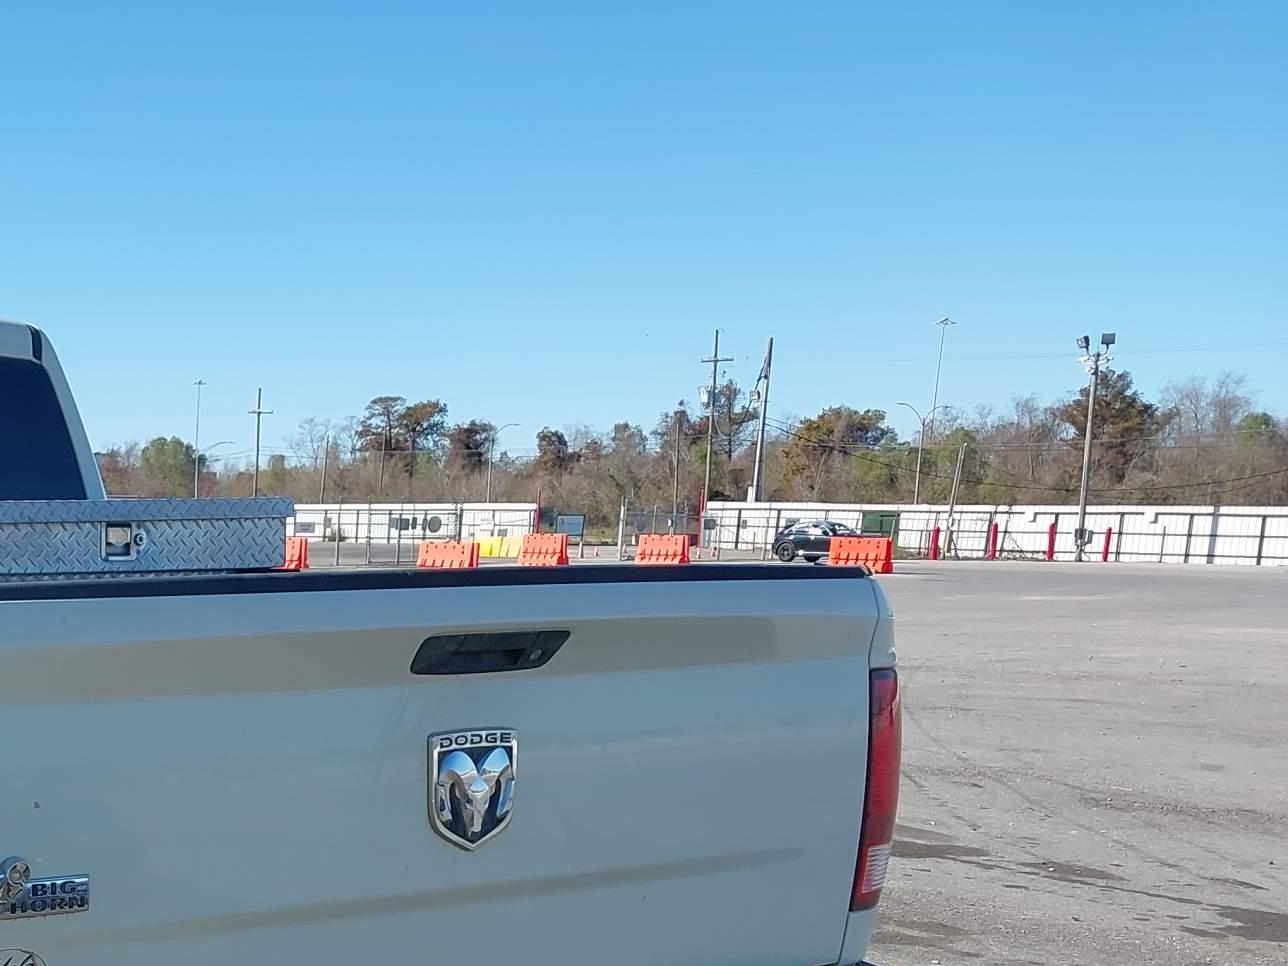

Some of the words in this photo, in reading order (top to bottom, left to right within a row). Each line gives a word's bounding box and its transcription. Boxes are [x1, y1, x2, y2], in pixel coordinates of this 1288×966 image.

[440, 732, 512, 749] DODGE
[31, 880, 78, 897] BIG
[9, 895, 85, 914] HORN
